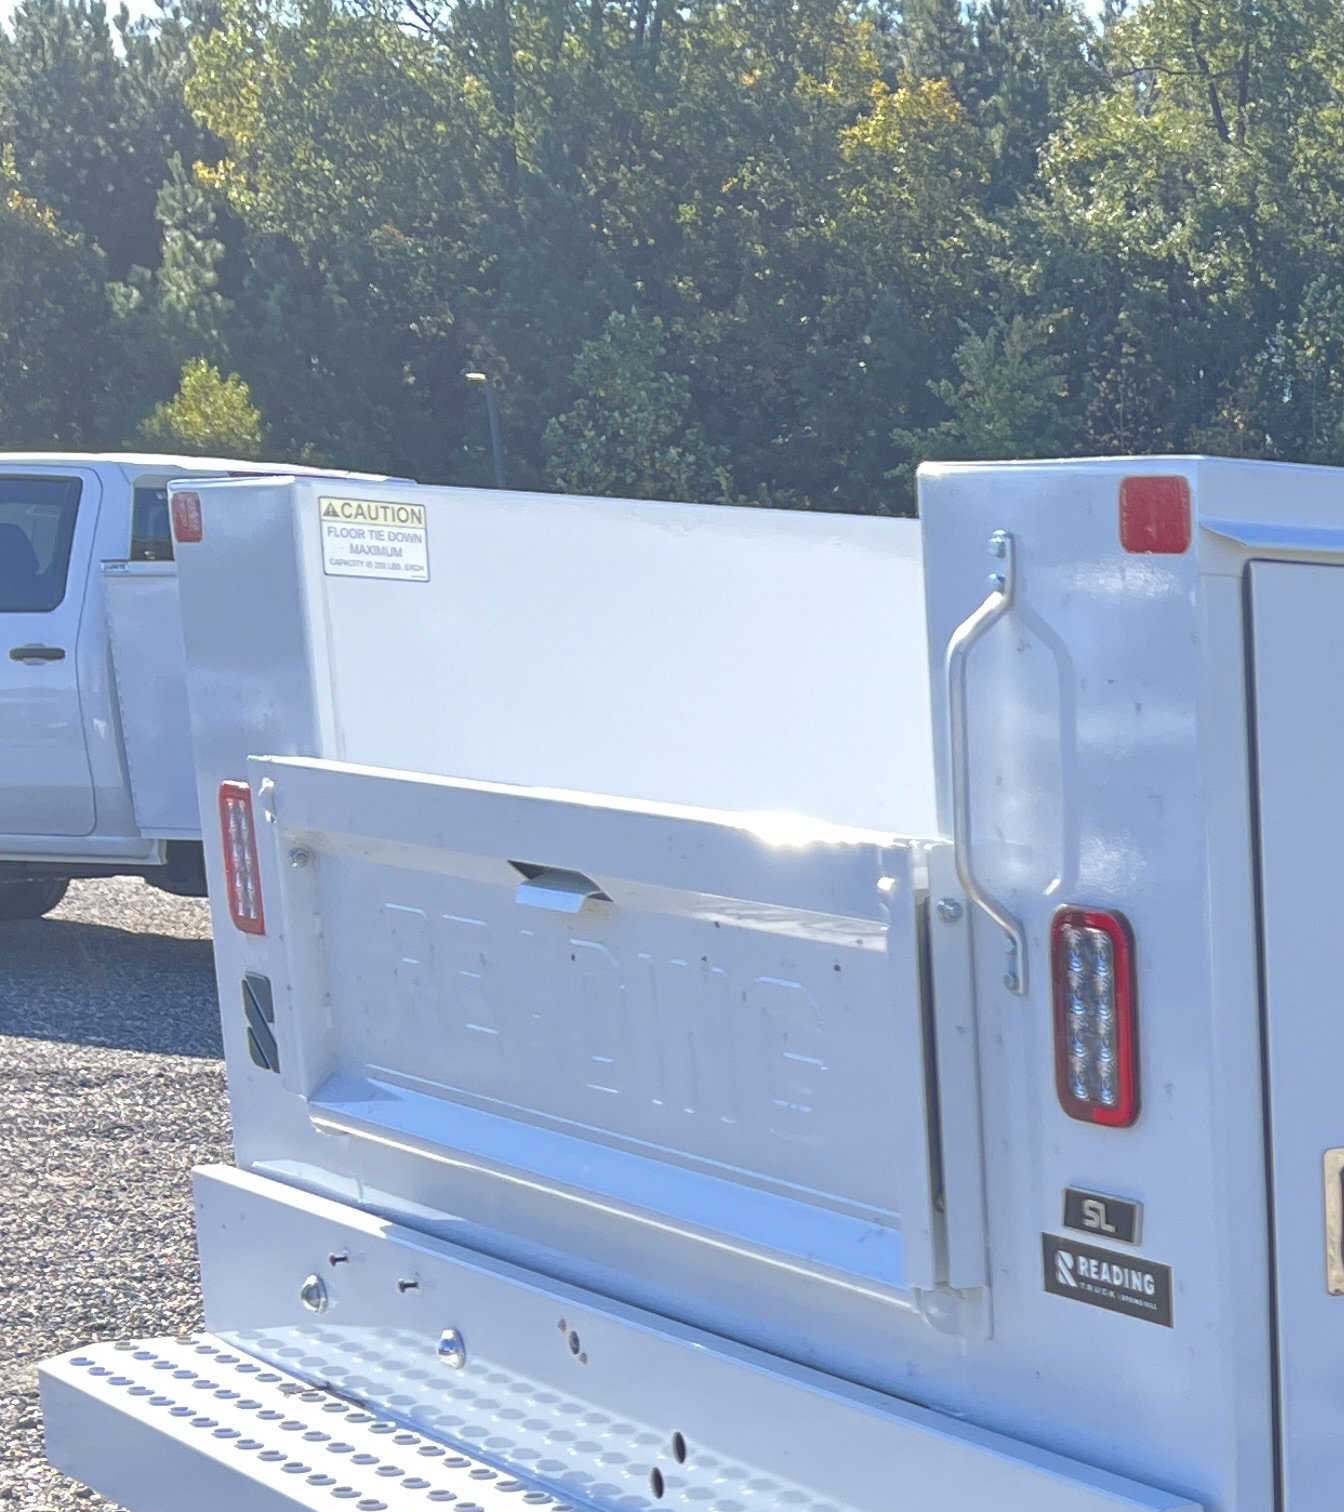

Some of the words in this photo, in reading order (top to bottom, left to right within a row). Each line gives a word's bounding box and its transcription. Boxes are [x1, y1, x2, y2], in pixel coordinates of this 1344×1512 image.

[340, 502, 422, 524] CAUTION
[327, 526, 365, 540] FLOOR
[368, 529, 385, 541] TIE
[388, 531, 422, 543] DOWN
[349, 543, 403, 557] MAXIMUM
[329, 557, 364, 568] CAPACITY
[404, 563, 424, 572] EACH
[1082, 1199, 1116, 1233] SL
[1077, 1255, 1155, 1295] READING
